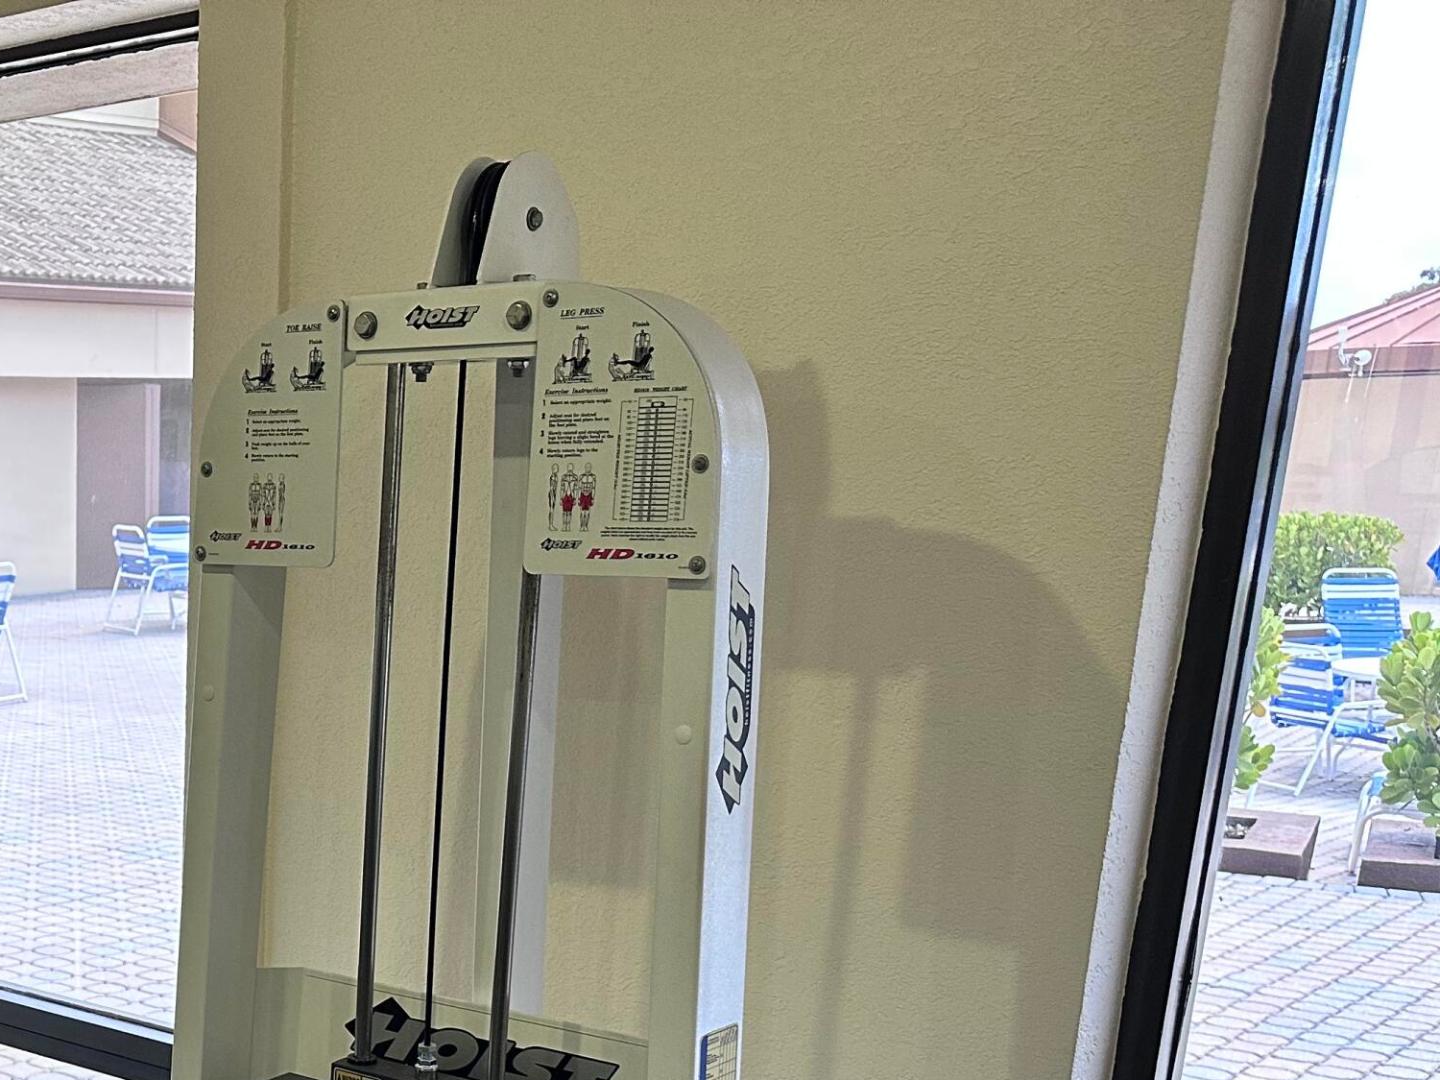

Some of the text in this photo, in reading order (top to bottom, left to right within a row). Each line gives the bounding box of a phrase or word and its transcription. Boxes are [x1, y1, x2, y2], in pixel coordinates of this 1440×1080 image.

[408, 305, 480, 326] HOIST
[560, 307, 605, 317] LEG PRESS
[244, 540, 282, 551] HD
[540, 537, 583, 551] HOIST
[585, 548, 636, 560] HD
[722, 564, 750, 806] HOIST
